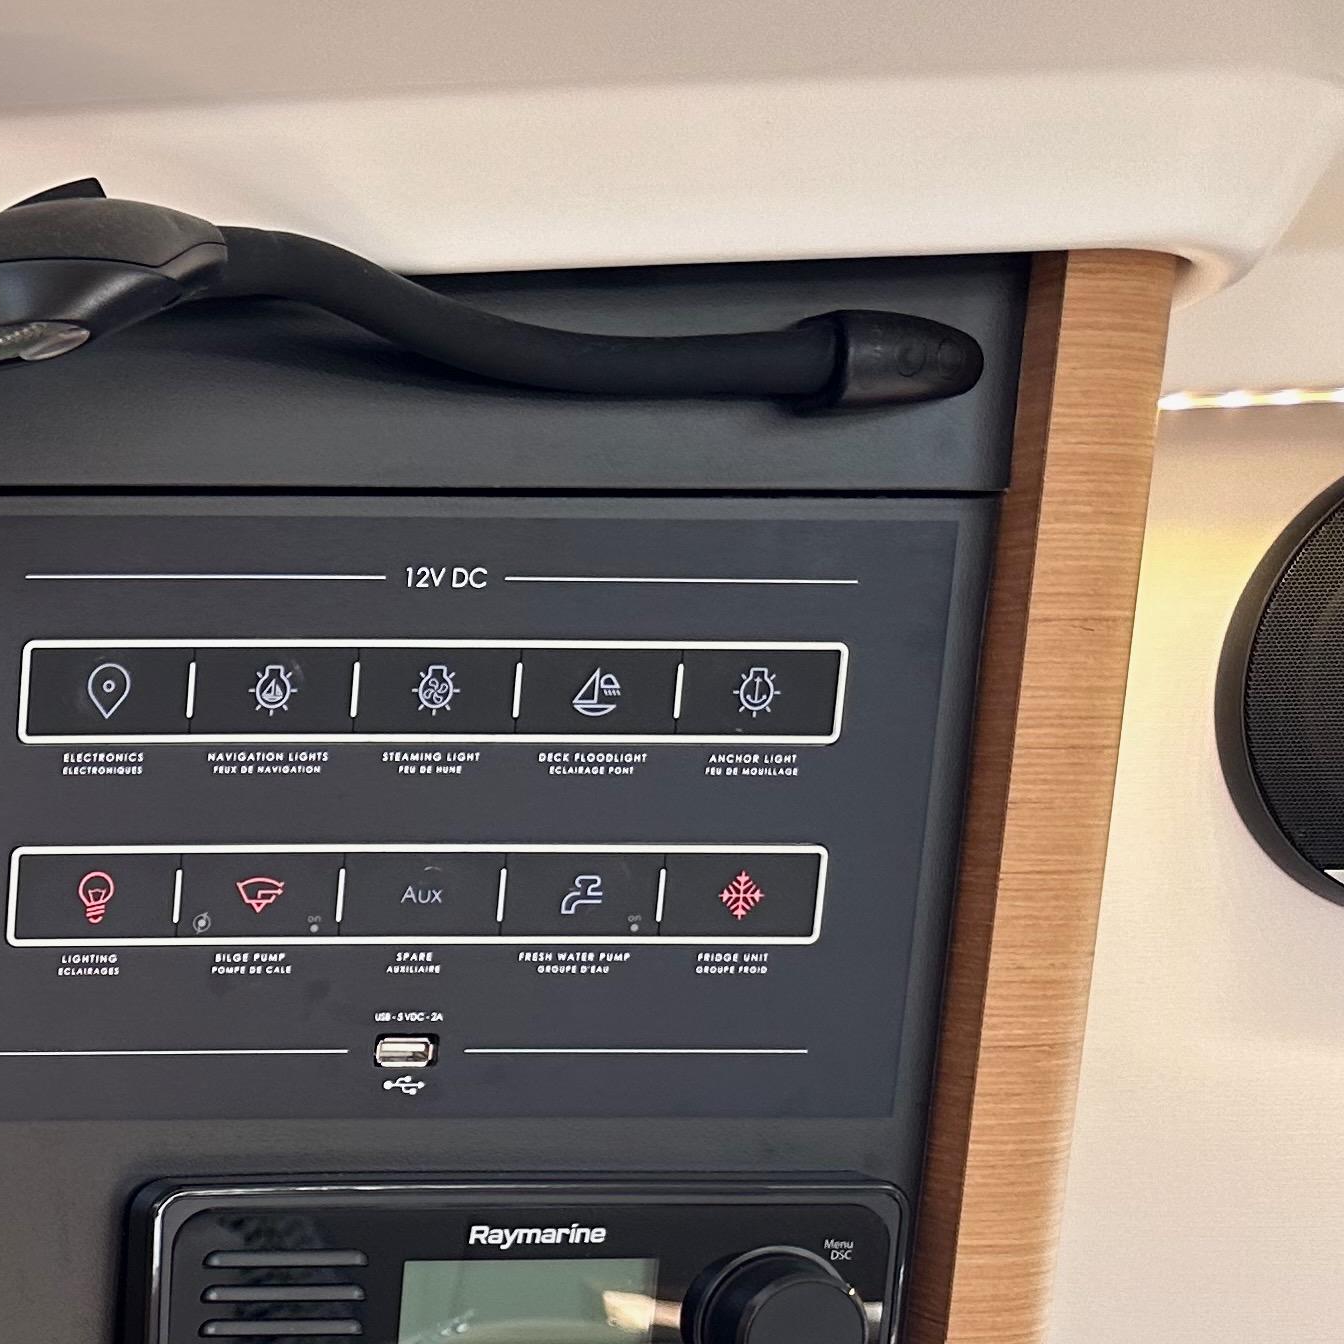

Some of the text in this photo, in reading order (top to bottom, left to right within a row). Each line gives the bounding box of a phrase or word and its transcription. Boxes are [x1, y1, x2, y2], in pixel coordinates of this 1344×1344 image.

[406, 567, 487, 588] 12V DC
[63, 752, 144, 763] ELECTRONICS
[207, 752, 329, 762] NAVIGATION LIGHTS
[382, 752, 481, 762] STEAMING LIGHT
[538, 752, 648, 763] DECK FLOODLIGHT
[708, 753, 798, 764] ANCHOR LIGHT
[62, 766, 143, 775] ELECTRONIQUES
[212, 765, 321, 774] FEUX DE NAVIGATION
[398, 765, 416, 774] FEU
[419, 765, 434, 774] DE
[548, 766, 605, 775] ECLAIRAGE
[704, 766, 724, 776] FEU
[742, 767, 798, 776] MOUILLAGE
[61, 954, 118, 964] LIGHTING
[215, 953, 286, 963] BILGE PUMP
[396, 952, 433, 962] SPARE
[518, 952, 631, 962] FRESH WATER PUMP
[697, 952, 769, 963] FRIDGE UNIT
[57, 966, 120, 976] ECLAIRAGES
[211, 965, 292, 975] POMPE DE CALE
[386, 965, 441, 974] AUXILIAIRE
[537, 965, 610, 974] GROUPE D'EAU
[695, 965, 768, 974] GROUPE FROID
[468, 1223, 607, 1250] Raymarine
[824, 1239, 853, 1249] Menu
[831, 1250, 852, 1260] DSC
